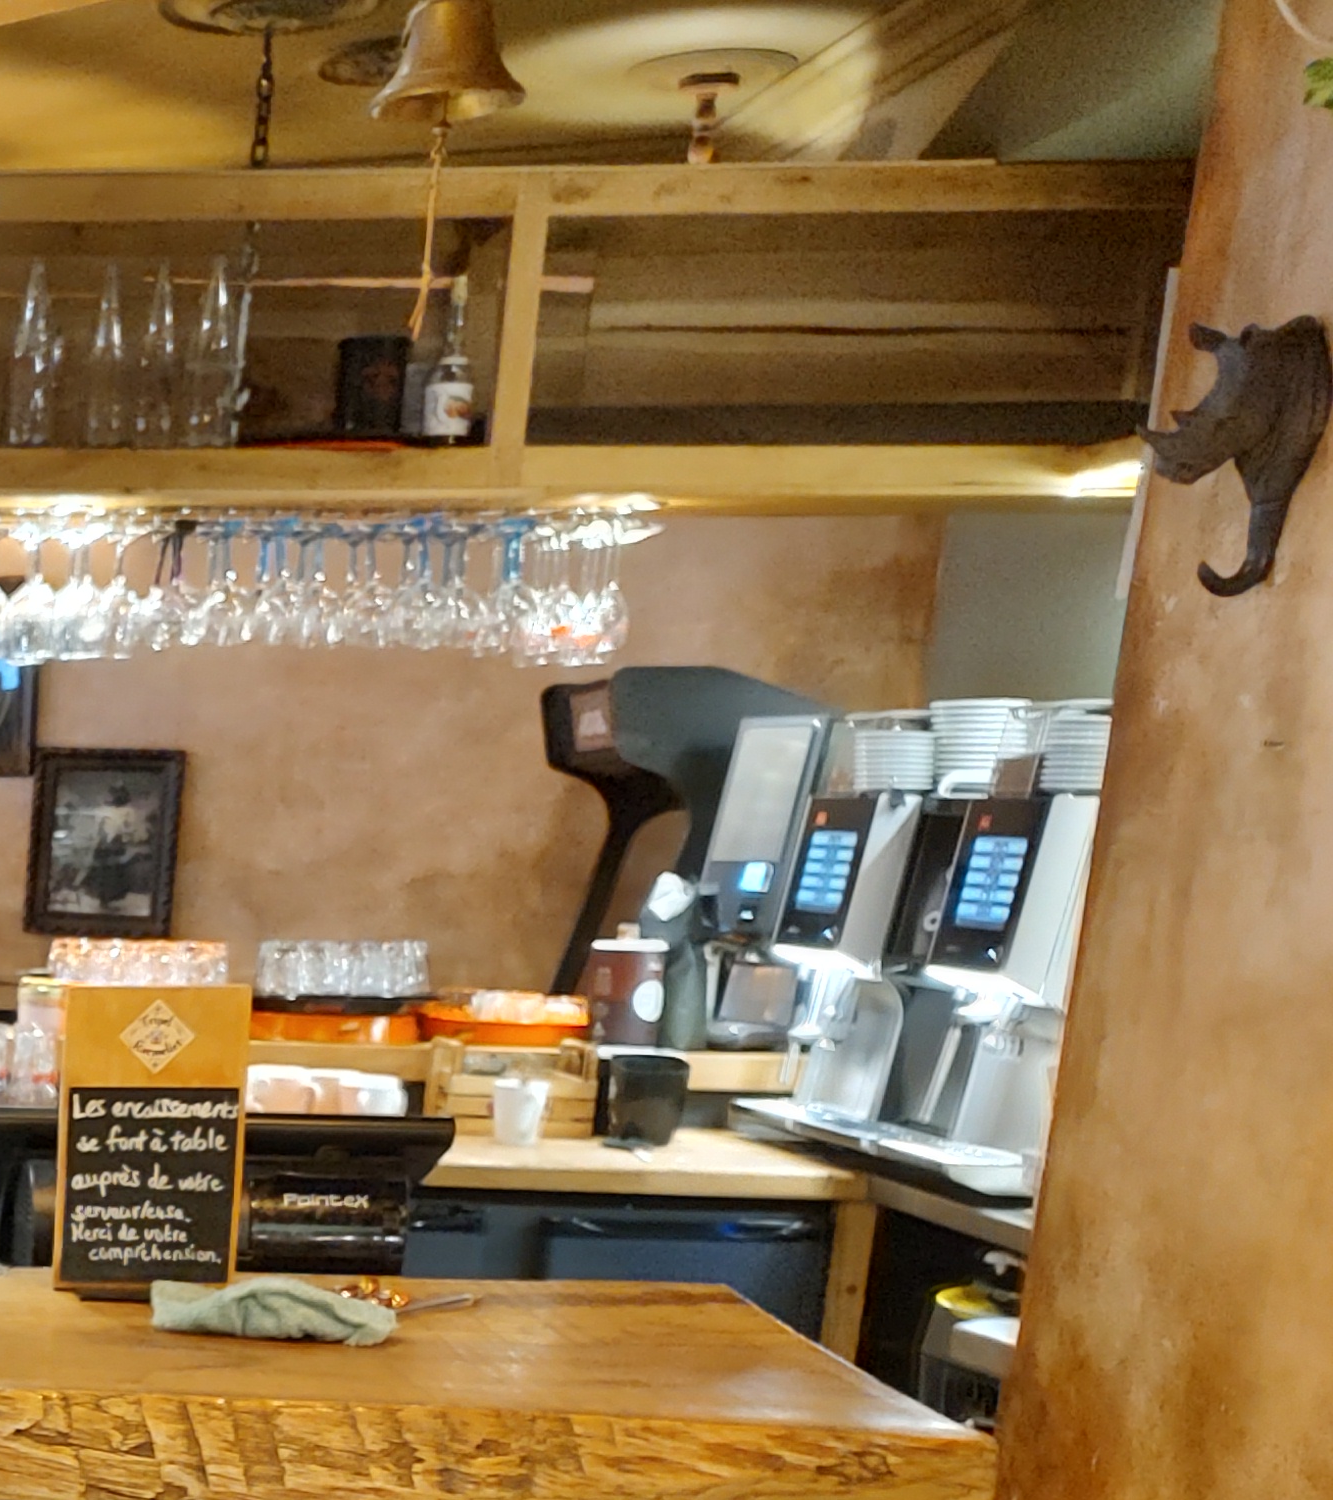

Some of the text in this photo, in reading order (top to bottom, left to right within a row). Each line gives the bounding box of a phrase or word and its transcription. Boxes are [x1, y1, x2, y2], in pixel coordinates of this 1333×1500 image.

[72, 1093, 107, 1119] Les
[105, 1125, 148, 1152] font
[149, 1128, 168, 1152] à
[170, 1126, 230, 1151] table
[71, 1163, 141, 1198] auprès
[147, 1162, 174, 1190] de
[71, 1223, 188, 1242] Merci de votre
